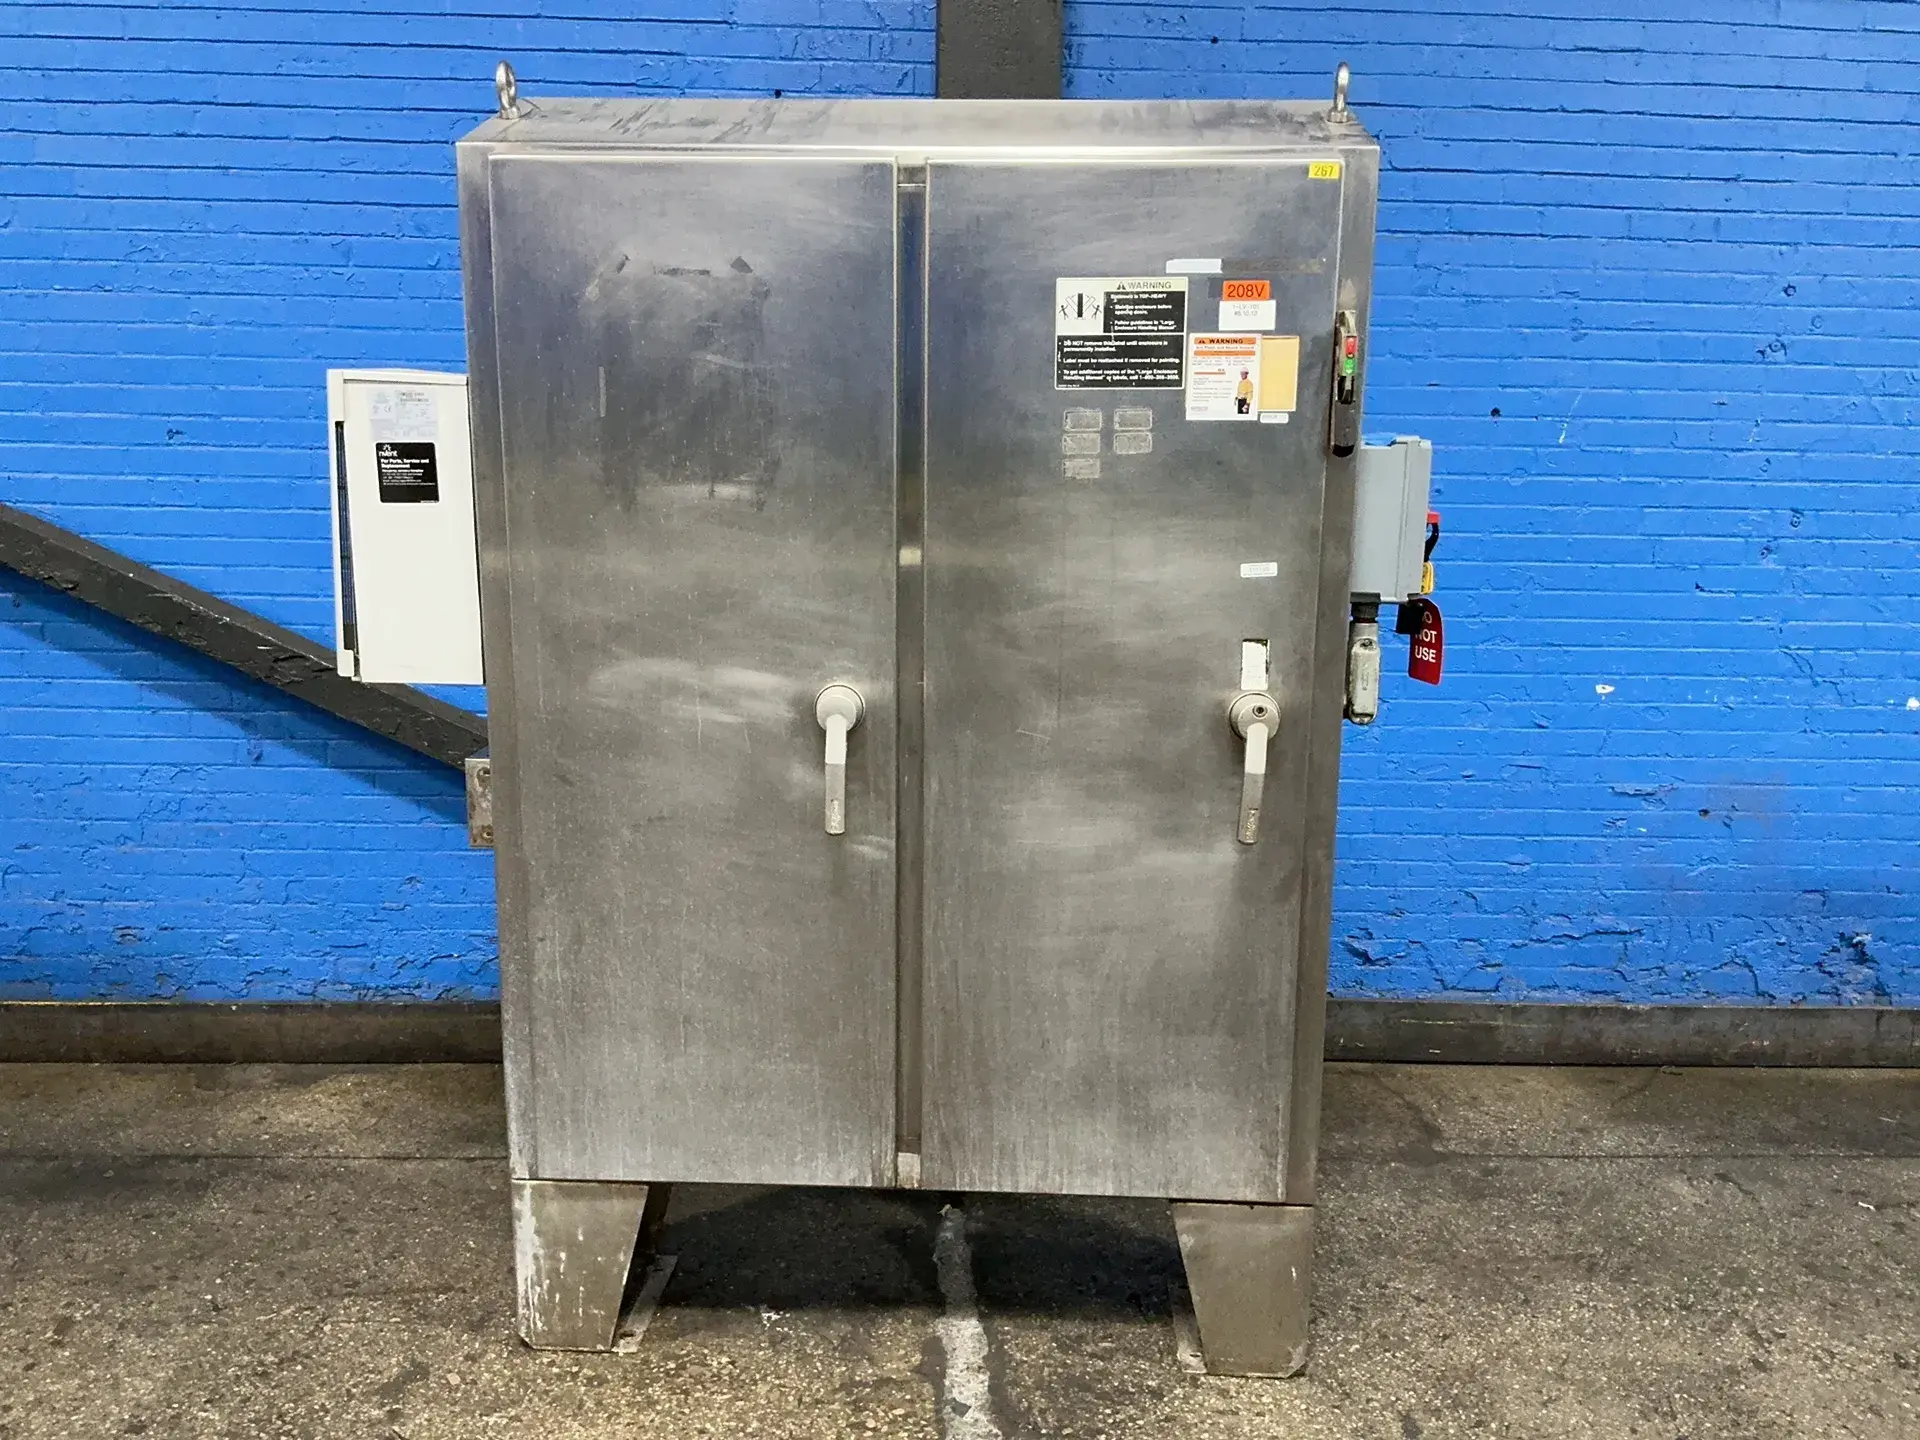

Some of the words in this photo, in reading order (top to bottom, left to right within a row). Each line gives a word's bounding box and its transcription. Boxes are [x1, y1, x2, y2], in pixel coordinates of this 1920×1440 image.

[1314, 165, 1334, 177] 267
[1128, 281, 1172, 289] WARNING
[1227, 284, 1266, 298] 208V
[1415, 645, 1437, 663] USE
